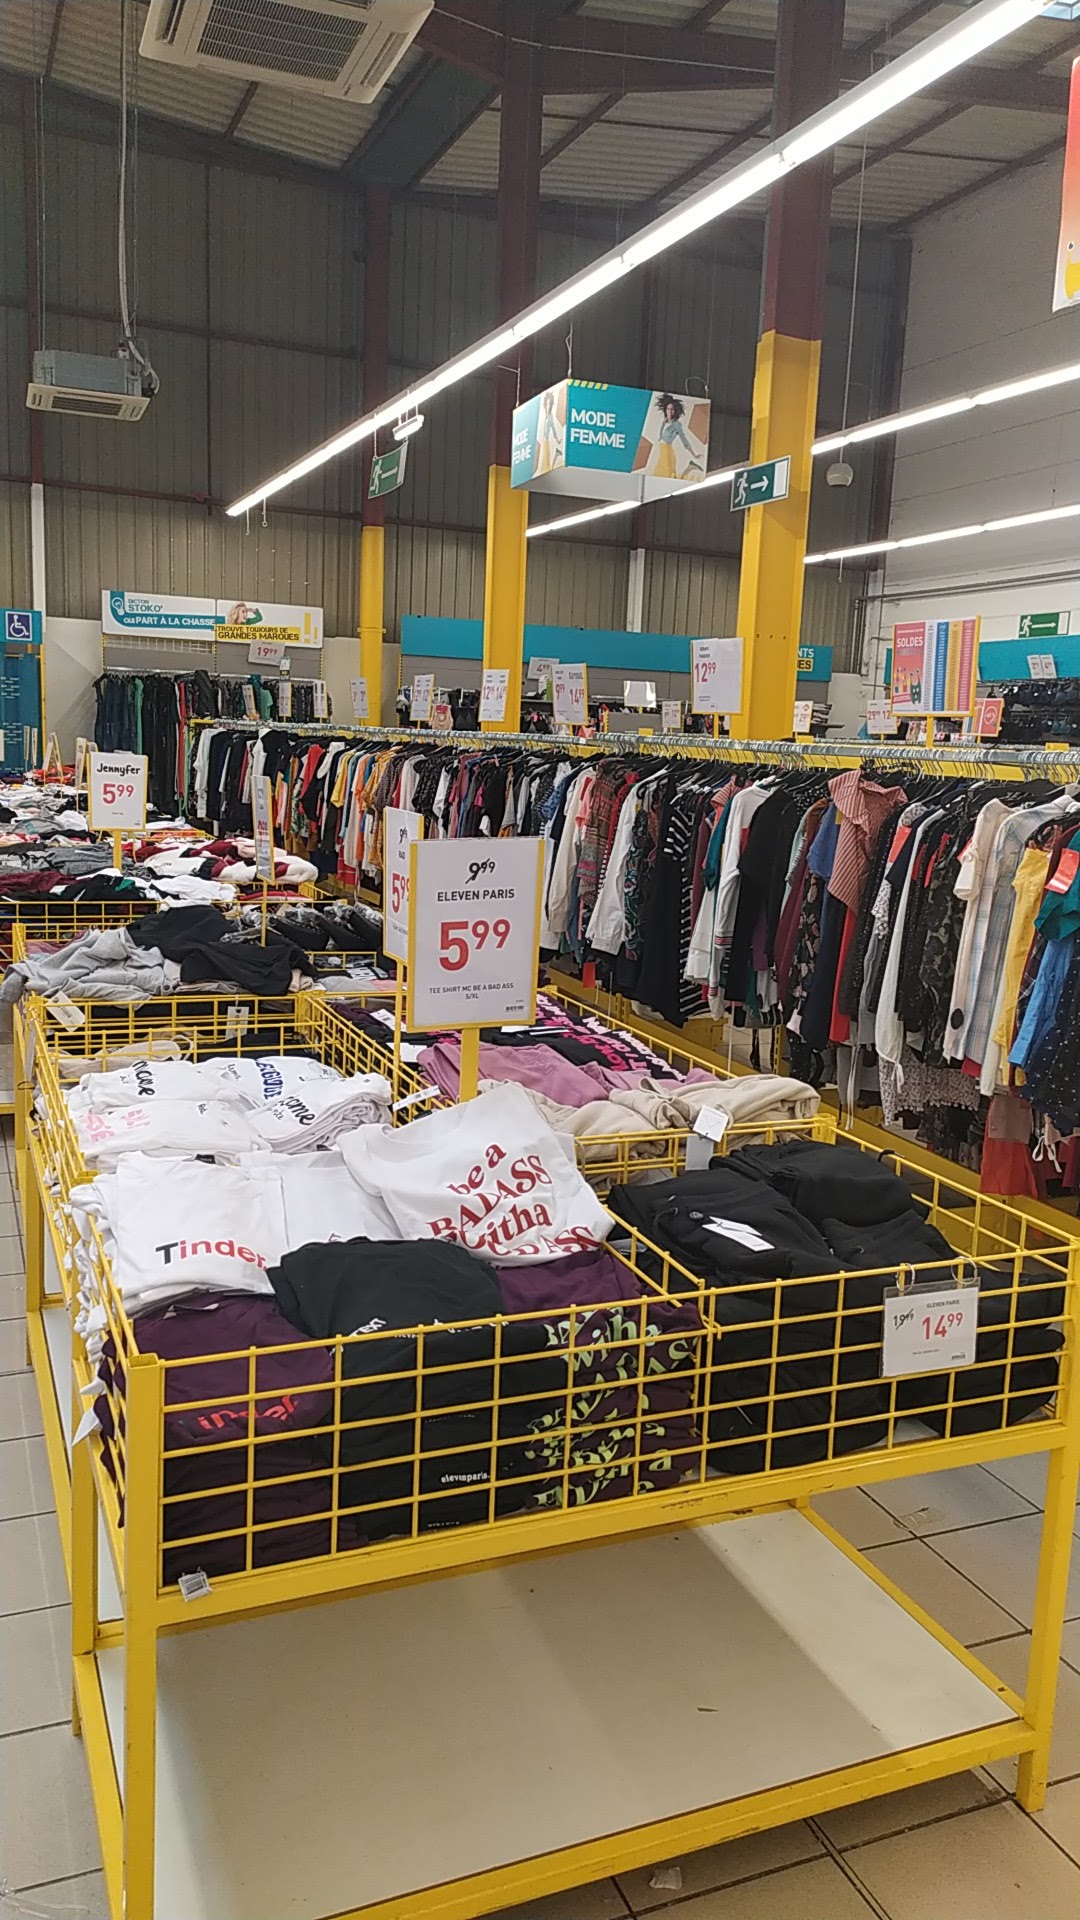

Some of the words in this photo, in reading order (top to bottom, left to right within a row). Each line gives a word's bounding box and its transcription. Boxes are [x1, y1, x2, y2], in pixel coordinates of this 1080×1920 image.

[571, 408, 616, 428] MODE
[513, 428, 528, 447] MODE
[571, 428, 625, 448] FEMME
[512, 444, 531, 465] FEMME
[136, 616, 158, 624] PART
[160, 616, 167, 625] À
[169, 617, 180, 625] LA
[182, 617, 216, 626] CHASSE
[218, 632, 257, 640] GRANDES
[259, 632, 300, 641] MARQUES
[896, 636, 923, 648] SOLDES
[97, 763, 141, 777] Jennyfer
[437, 889, 480, 902] ELEVEN
[483, 888, 515, 900] PARIS
[447, 1164, 485, 1197] be
[485, 1143, 507, 1169] a
